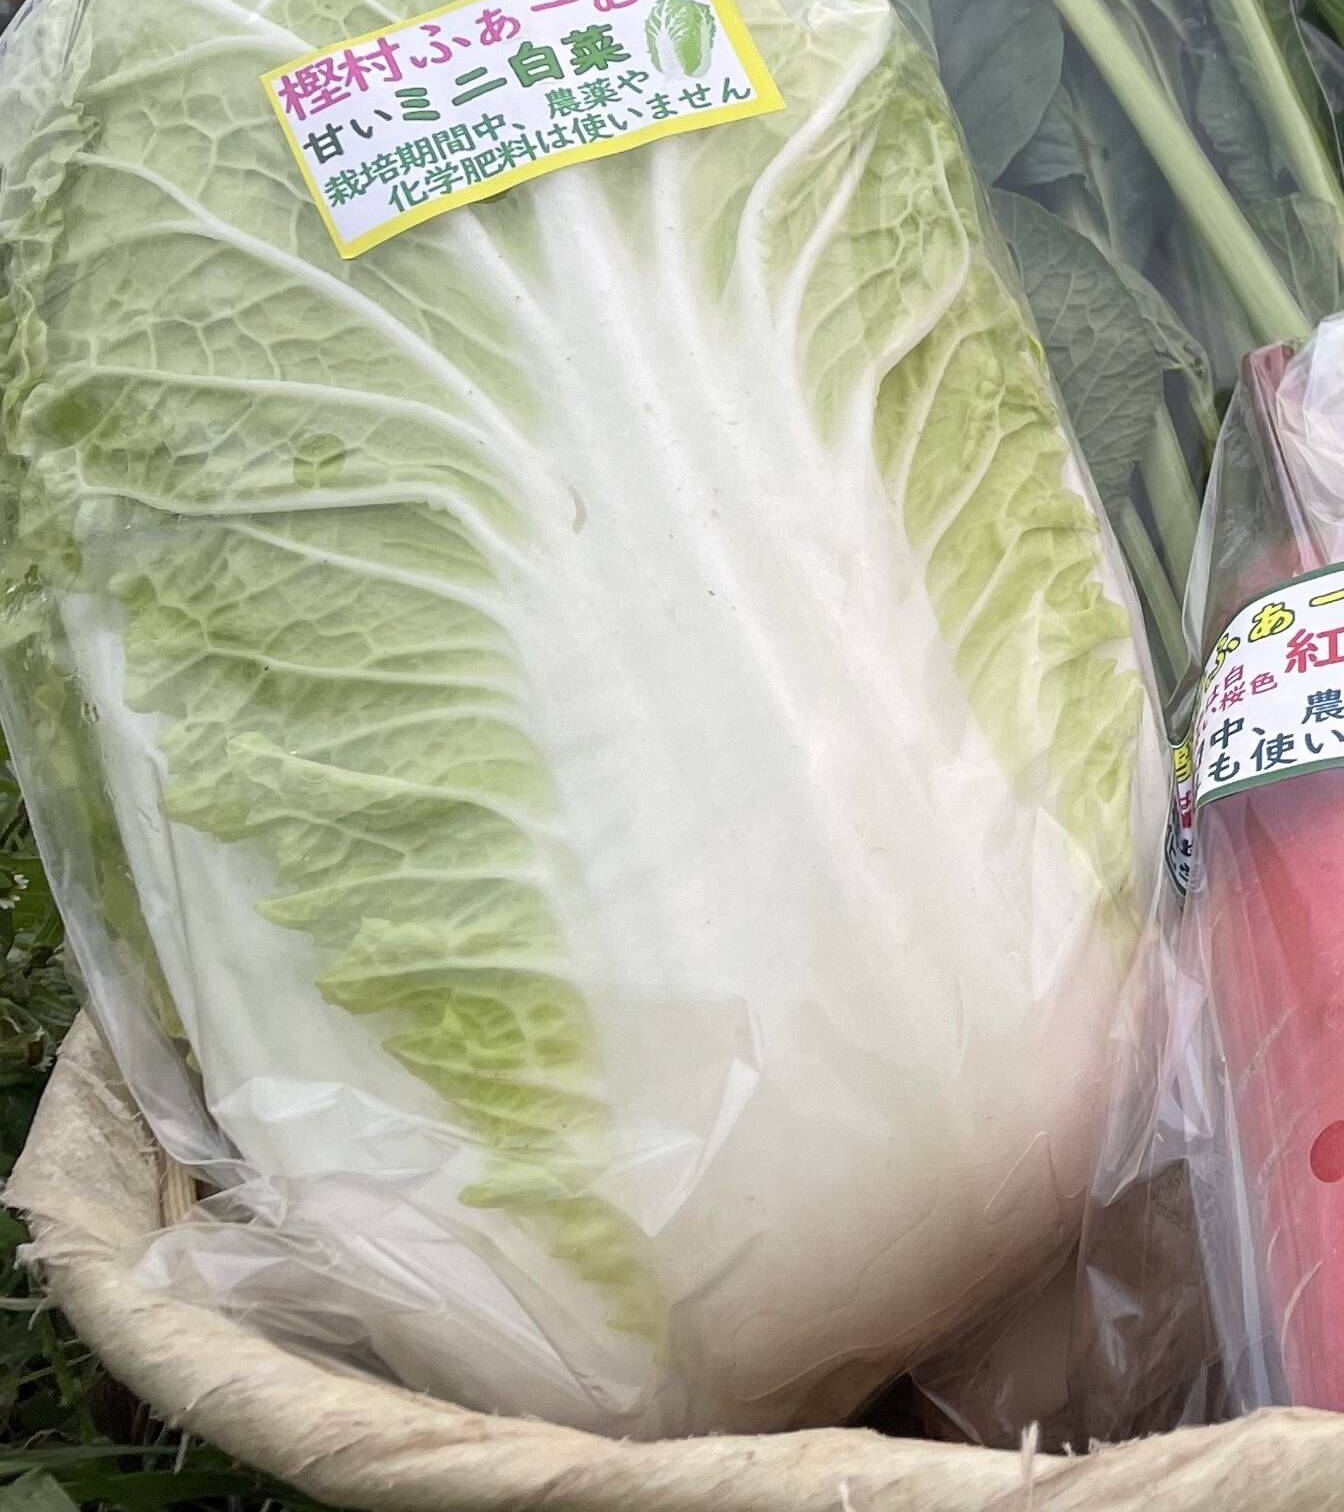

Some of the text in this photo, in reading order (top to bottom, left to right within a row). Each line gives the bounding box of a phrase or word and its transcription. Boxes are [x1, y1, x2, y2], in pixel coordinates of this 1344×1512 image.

[302, 23, 632, 166] 甘いミニ白菜
[388, 76, 752, 213] 化学肥料は使いません
